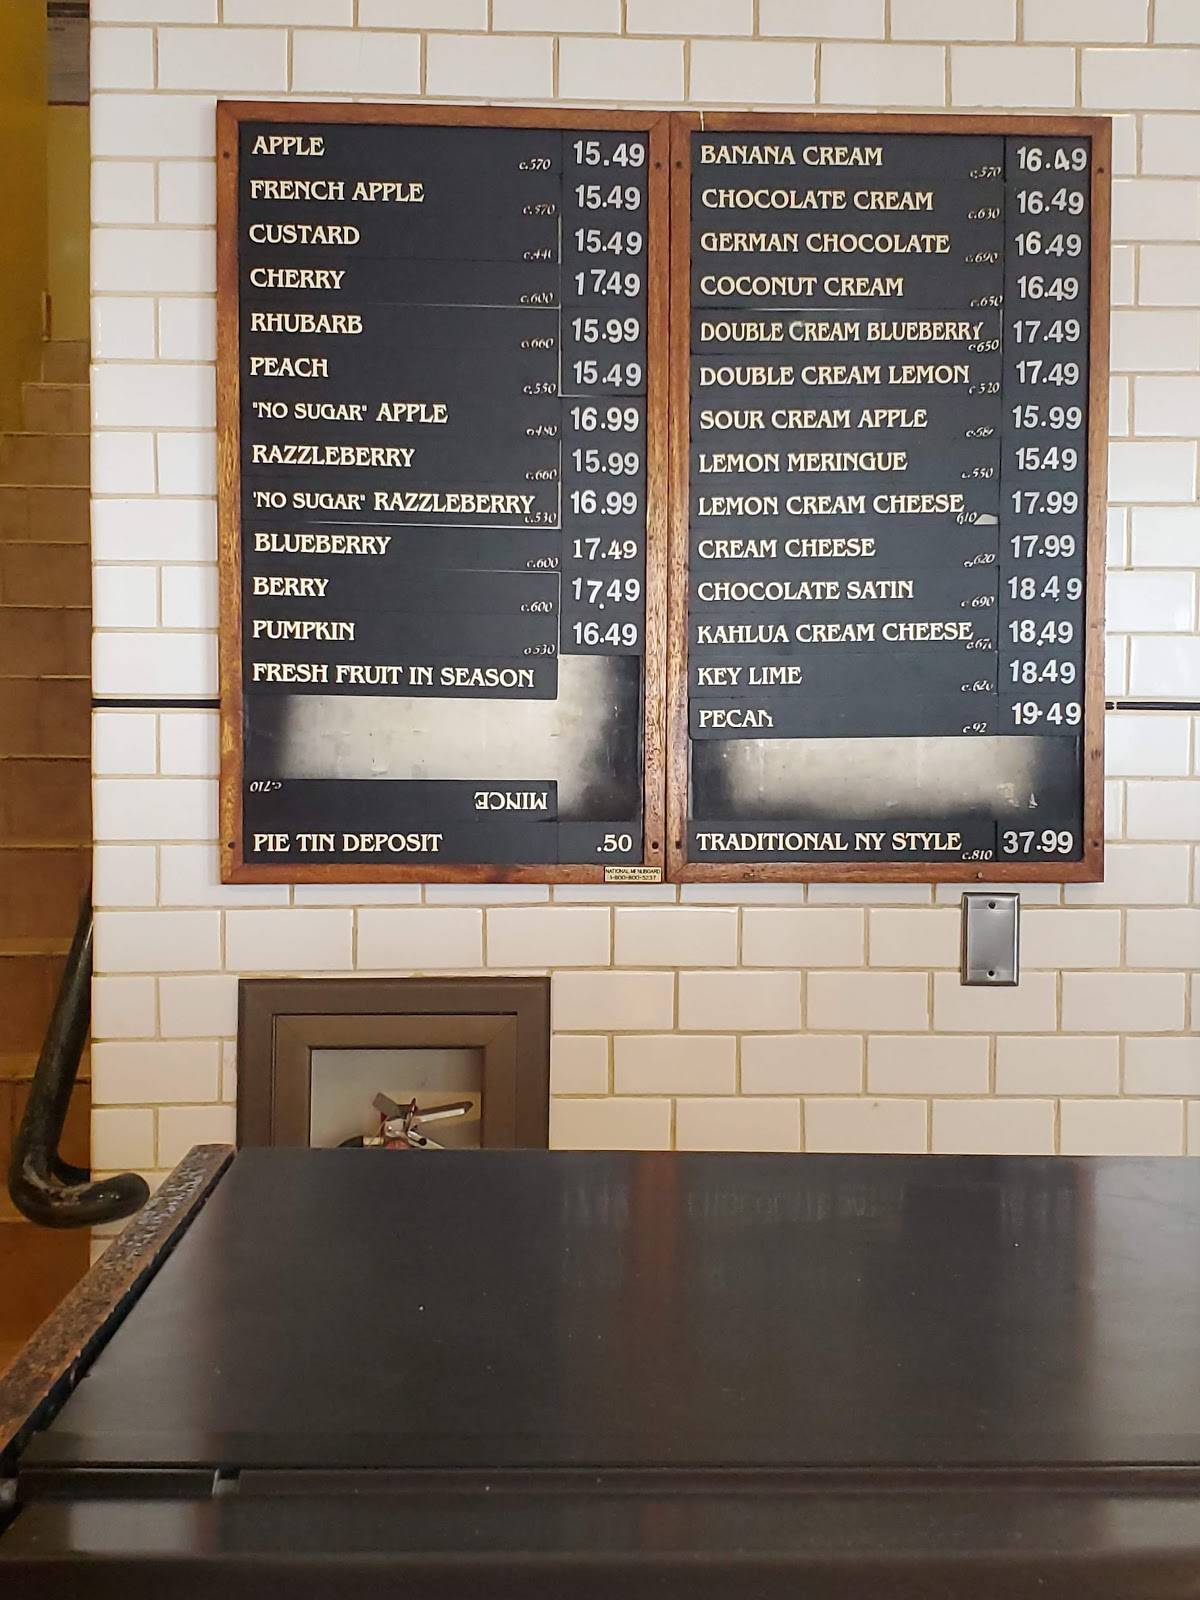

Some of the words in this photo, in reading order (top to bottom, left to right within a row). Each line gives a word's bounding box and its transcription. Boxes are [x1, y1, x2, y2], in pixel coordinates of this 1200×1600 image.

[252, 136, 324, 156] APPLE
[574, 141, 644, 166] 15.49
[701, 146, 796, 164] BANANA
[803, 146, 882, 165] CREAM
[519, 159, 550, 169] c.570
[1017, 147, 1086, 171] 16.49
[250, 180, 344, 200] FRENCH
[352, 182, 424, 202] APPLE
[576, 185, 640, 210] 15.49
[702, 189, 846, 209] CHOCOLATE
[854, 191, 933, 210] CREAM
[1017, 188, 1083, 214] 16.49
[523, 204, 555, 215] c.570
[250, 224, 359, 244] CUSTARD
[575, 229, 642, 254] 15.49
[701, 233, 798, 252] GERMAN
[806, 233, 950, 253] CHOCOLATE
[1015, 231, 1081, 256] 16.49
[250, 268, 345, 289] CHERRY
[575, 269, 640, 296] 17.49
[701, 276, 817, 295] COCONUT
[824, 278, 903, 296] CREAM
[1018, 276, 1078, 300] 16.49
[251, 313, 362, 333] RHUBARB
[573, 318, 639, 343] 15.99
[701, 322, 783, 341] DOUBLE
[789, 321, 860, 341] CREAM
[867, 322, 983, 340] BLUEBERRY
[1014, 319, 1080, 343] 17.49
[251, 357, 328, 377] PEACH
[574, 361, 641, 386] 15.49
[700, 367, 794, 385] DOUBLE
[802, 366, 881, 385] CREAM
[889, 366, 969, 383] LEMON
[1016, 360, 1079, 385] 17.49
[524, 383, 556, 394] c.550
[253, 402, 288, 418] "NO
[295, 403, 367, 420] SUGAR"
[376, 403, 448, 423] APPLE
[571, 407, 638, 431] 16.99
[700, 411, 765, 429] SOUR
[772, 410, 850, 428] CREAM
[857, 409, 927, 428] APPLE
[1013, 405, 1081, 429] 15.99
[253, 445, 415, 467] RAZZLEBERRY
[573, 449, 639, 475] 15.99
[699, 454, 779, 472] LEMON
[788, 452, 908, 472] MERINGUE
[1016, 447, 1077, 471] 15.49
[293, 493, 365, 510] SUGAR"
[374, 492, 535, 513] RAZZLEBERRY
[571, 490, 637, 514] 16.99
[699, 497, 778, 515] LEMON
[787, 496, 865, 514] CREAM
[873, 494, 964, 513] CHEESE
[1012, 491, 1078, 514] 17.99
[255, 533, 391, 554] BLUEBERRY
[574, 538, 637, 560] 17.49
[699, 540, 777, 558] CREAM
[785, 538, 875, 557] CHEESE
[1011, 535, 1075, 558] 17.99
[527, 558, 558, 568] c.600
[253, 577, 328, 596] BERRY
[573, 578, 640, 609] 17.49
[698, 582, 840, 601] CHOCOLATE
[847, 581, 913, 599] SATIN
[1008, 576, 1082, 601] 18.49
[521, 602, 552, 612] c.600
[253, 620, 354, 640] PUMPKIN
[573, 622, 637, 646] 16.49
[697, 625, 789, 643] KAHLUA
[796, 624, 875, 642] CREAM
[882, 622, 973, 641] CHEESE
[1009, 620, 1073, 646] 18.49
[253, 663, 328, 682] FRESH
[336, 665, 403, 684] FRUIT
[409, 667, 433, 685] IN
[440, 668, 534, 687] SEASON
[698, 668, 742, 685] KEY
[749, 667, 802, 684] LIME
[1010, 660, 1075, 684] 18.49
[250, 781, 281, 791] c.710
[474, 792, 547, 809] MINCE
[254, 834, 290, 851] PIE
[296, 834, 335, 851] TIN
[343, 834, 442, 851] DEPOSIT
[597, 835, 632, 851] .50
[696, 833, 848, 850] TRADITIONAL
[855, 833, 885, 850] NY
[892, 833, 961, 850] STYLE
[1004, 830, 1073, 853] 37.99
[962, 850, 992, 860] c.810
